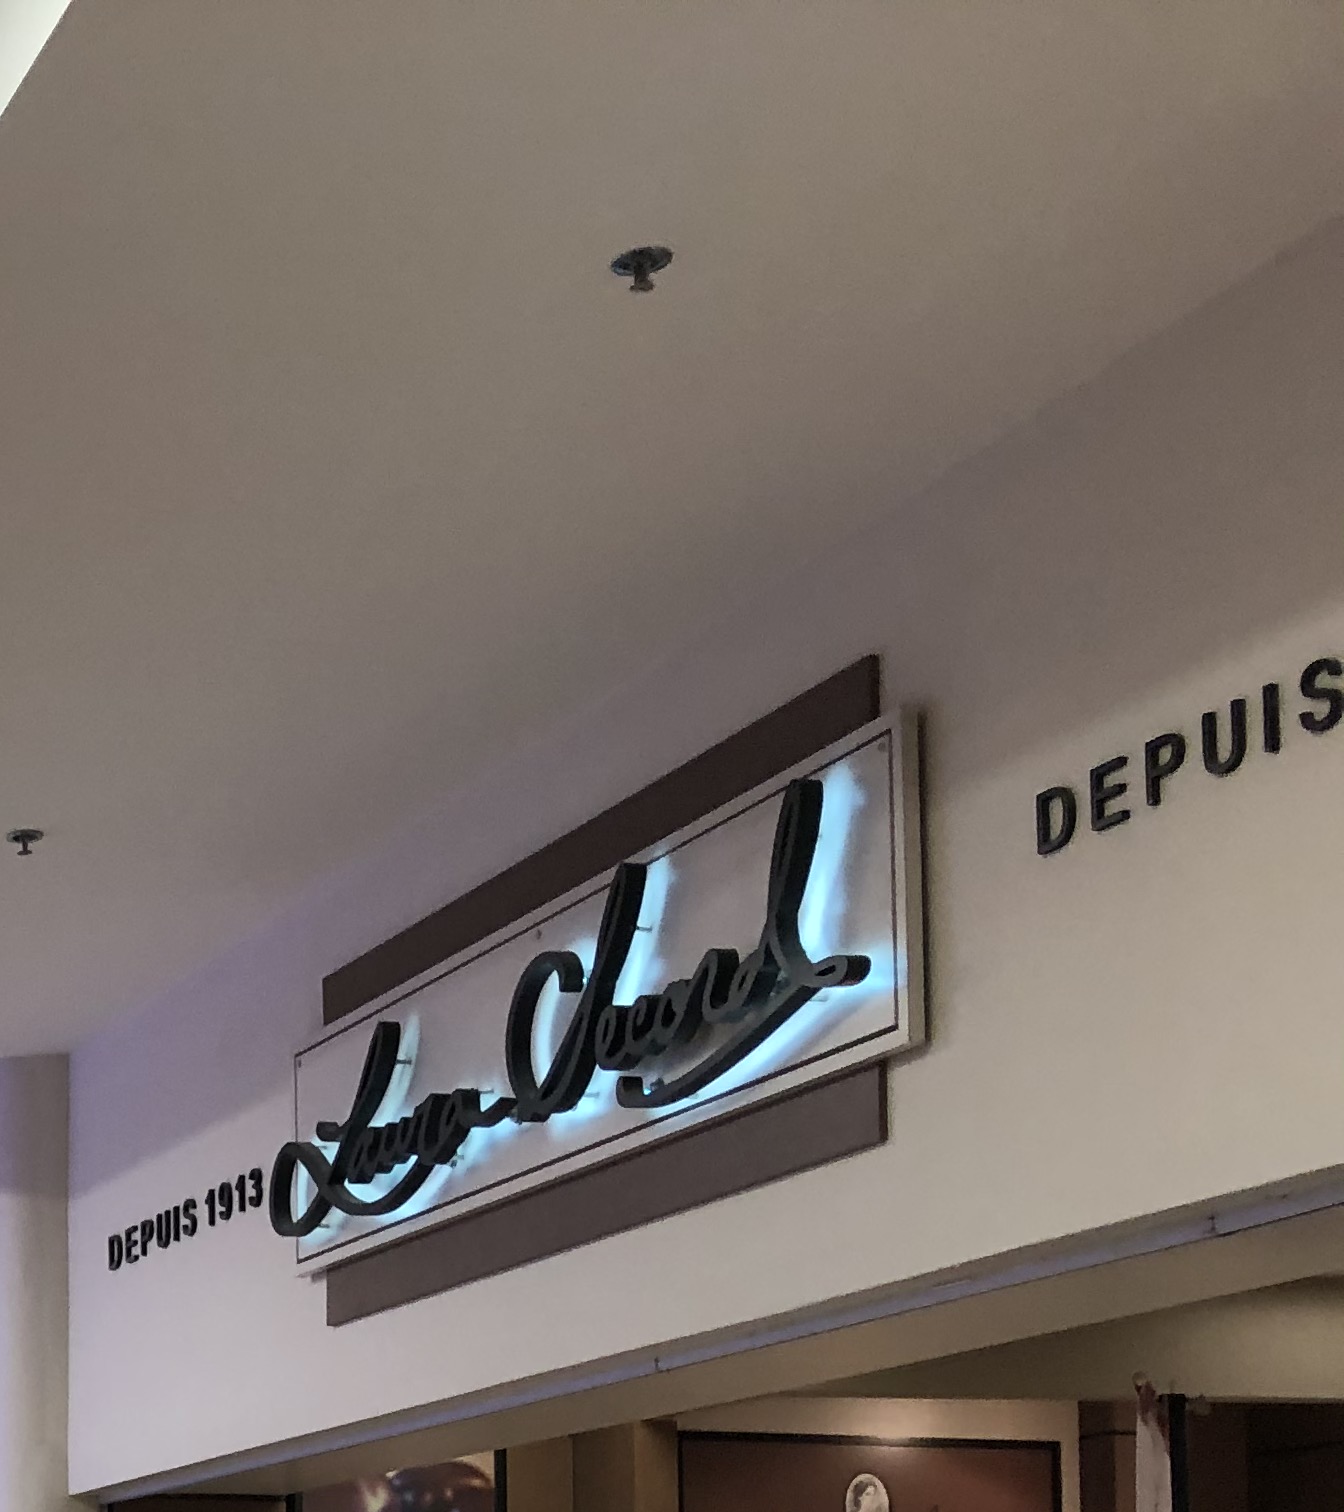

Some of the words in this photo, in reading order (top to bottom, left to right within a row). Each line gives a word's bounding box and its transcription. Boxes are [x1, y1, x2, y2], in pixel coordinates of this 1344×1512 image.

[1035, 656, 1344, 856] DEPUIS
[270, 1021, 516, 1237] Laura
[506, 779, 872, 1123] Secord
[108, 1198, 198, 1271] DEPUIS
[204, 1167, 263, 1228] 1913
